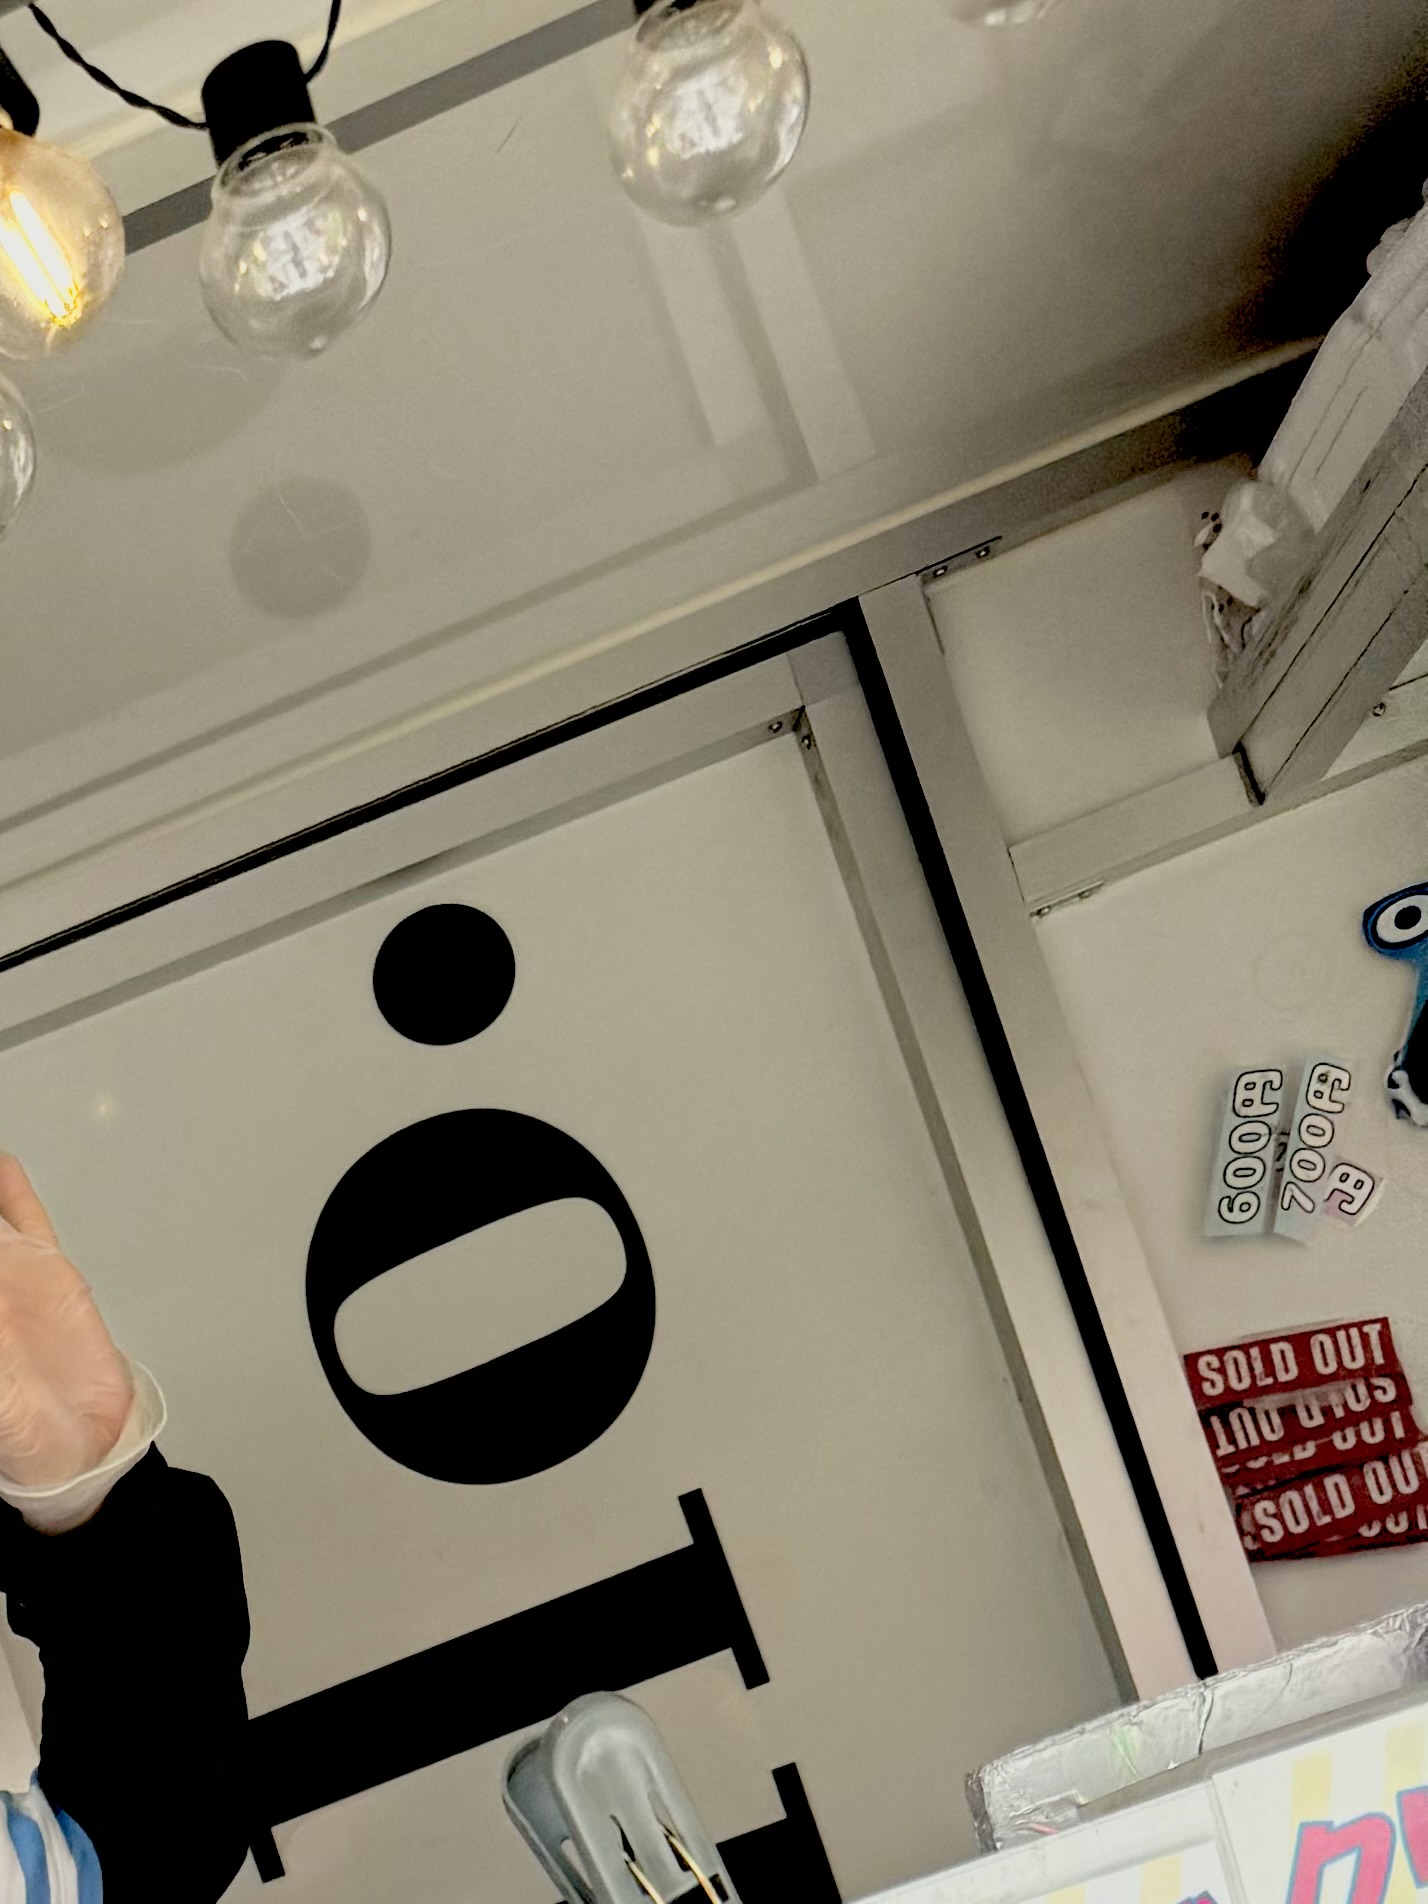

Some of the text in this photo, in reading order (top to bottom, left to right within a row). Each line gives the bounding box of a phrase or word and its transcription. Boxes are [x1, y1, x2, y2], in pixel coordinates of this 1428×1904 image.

[1219, 1068, 1283, 1224] 600円
[1281, 1062, 1350, 1213] 700円
[1197, 1323, 1385, 1396] SOLD OUT
[1253, 1474, 1355, 1543] SOLD
